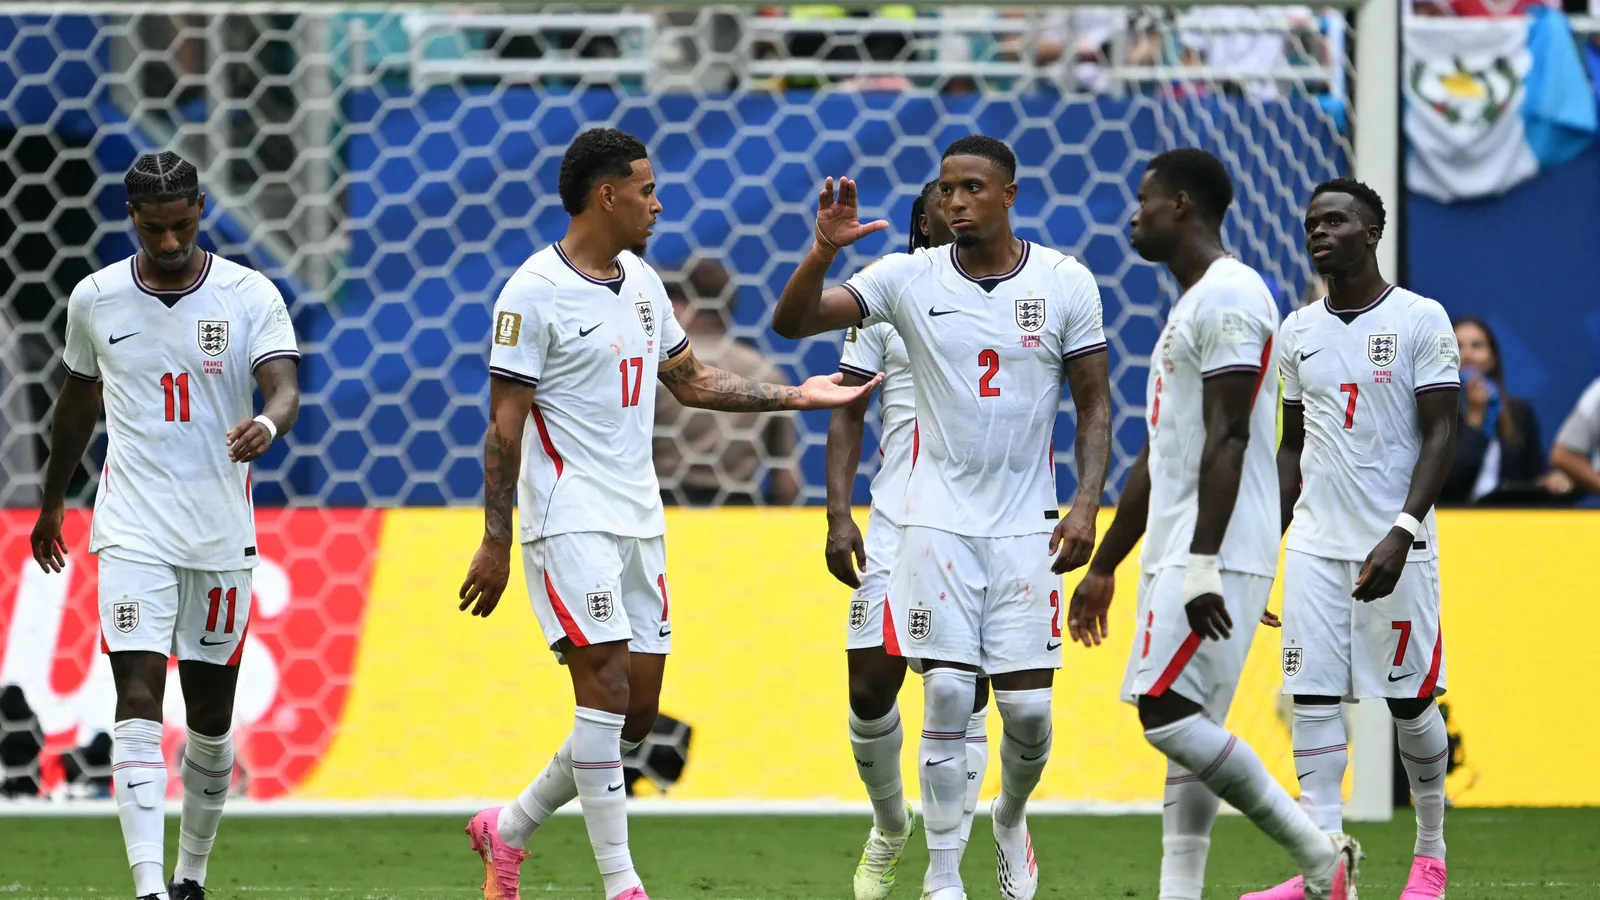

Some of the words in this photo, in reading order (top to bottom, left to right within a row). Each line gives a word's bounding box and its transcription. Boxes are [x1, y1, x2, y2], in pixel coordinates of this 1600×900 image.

[619, 357, 643, 408] 17
[978, 349, 1000, 397] 2
[160, 373, 190, 422] 11
[1340, 383, 1358, 429] 7
[205, 587, 237, 634] 11
[1050, 590, 1061, 637] 2
[1392, 621, 1411, 666] 7
